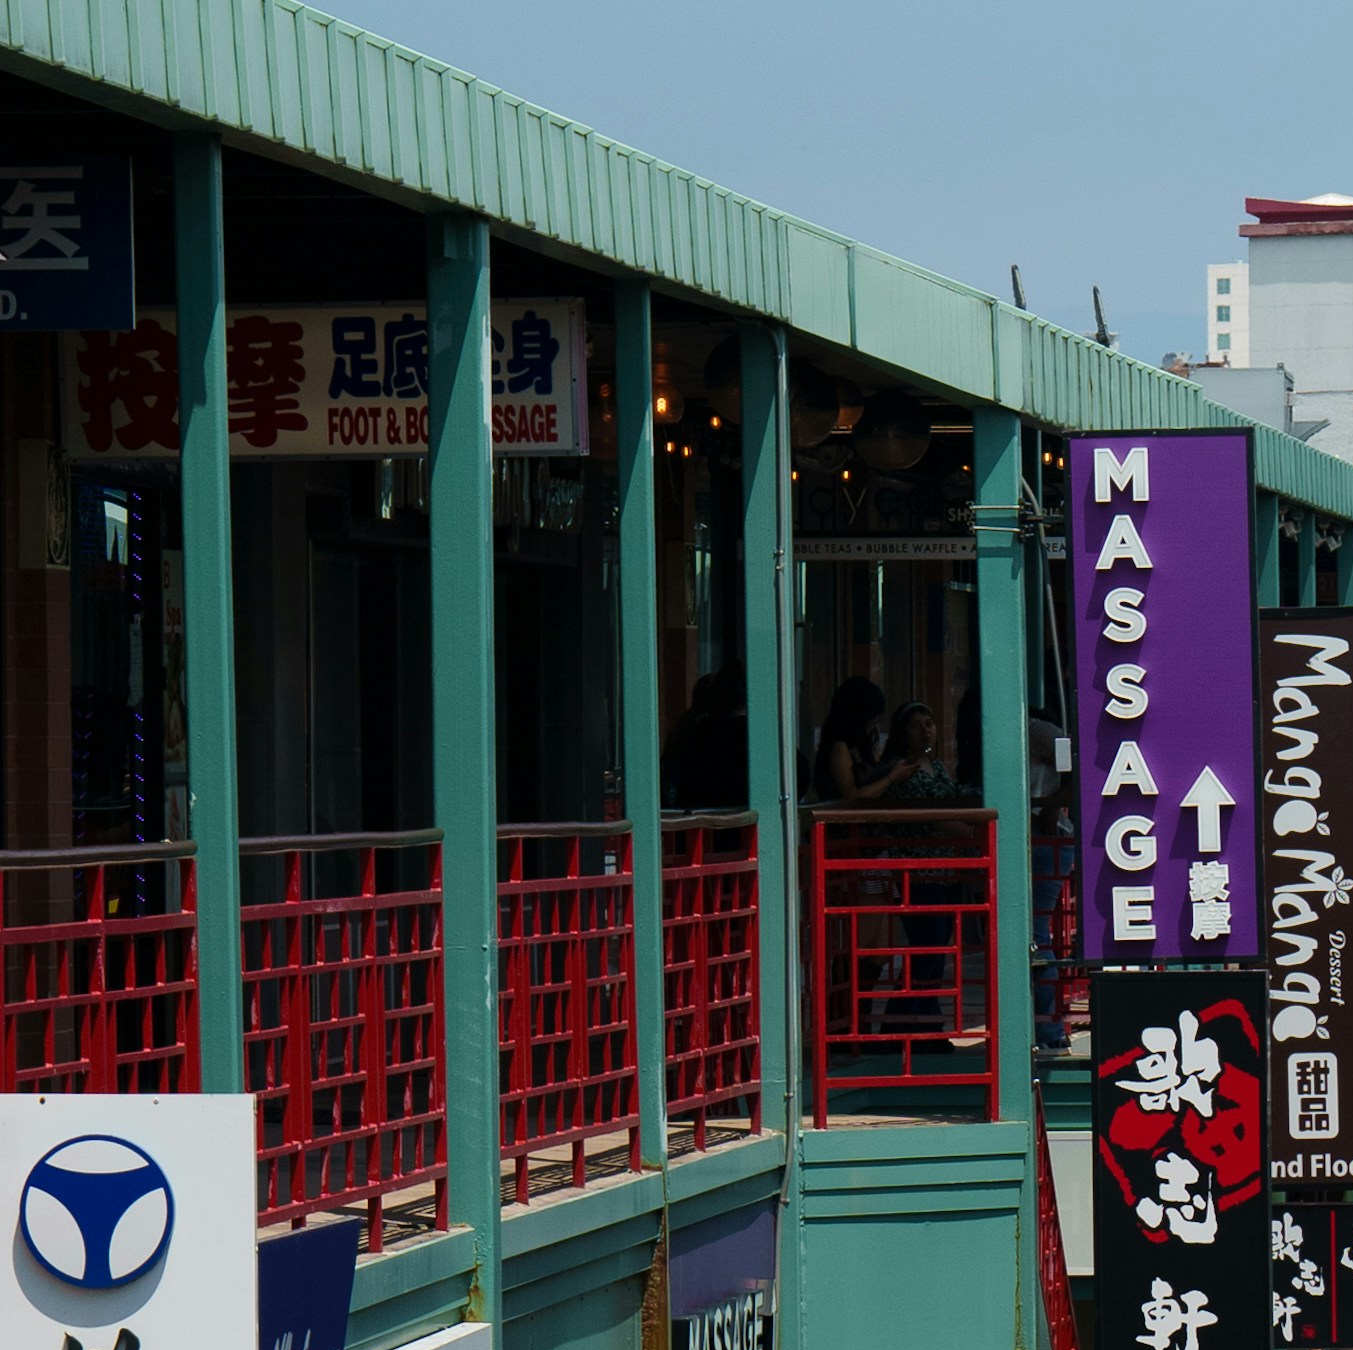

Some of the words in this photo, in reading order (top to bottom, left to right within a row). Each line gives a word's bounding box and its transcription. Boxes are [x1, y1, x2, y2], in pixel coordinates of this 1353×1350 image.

[328, 406, 381, 446] FOOT
[386, 407, 402, 445] &
[491, 404, 558, 445] SSAGE
[826, 543, 852, 554] TEAS
[866, 543, 909, 554] BUBBLE
[913, 543, 958, 554] WAFFLE
[1093, 446, 1160, 942] MASSAGE
[1188, 861, 1233, 942] 按摩
[1326, 930, 1347, 1007] Dessert
[1295, 1060, 1331, 1133] 甜品
[1271, 1152, 1306, 1178] nd
